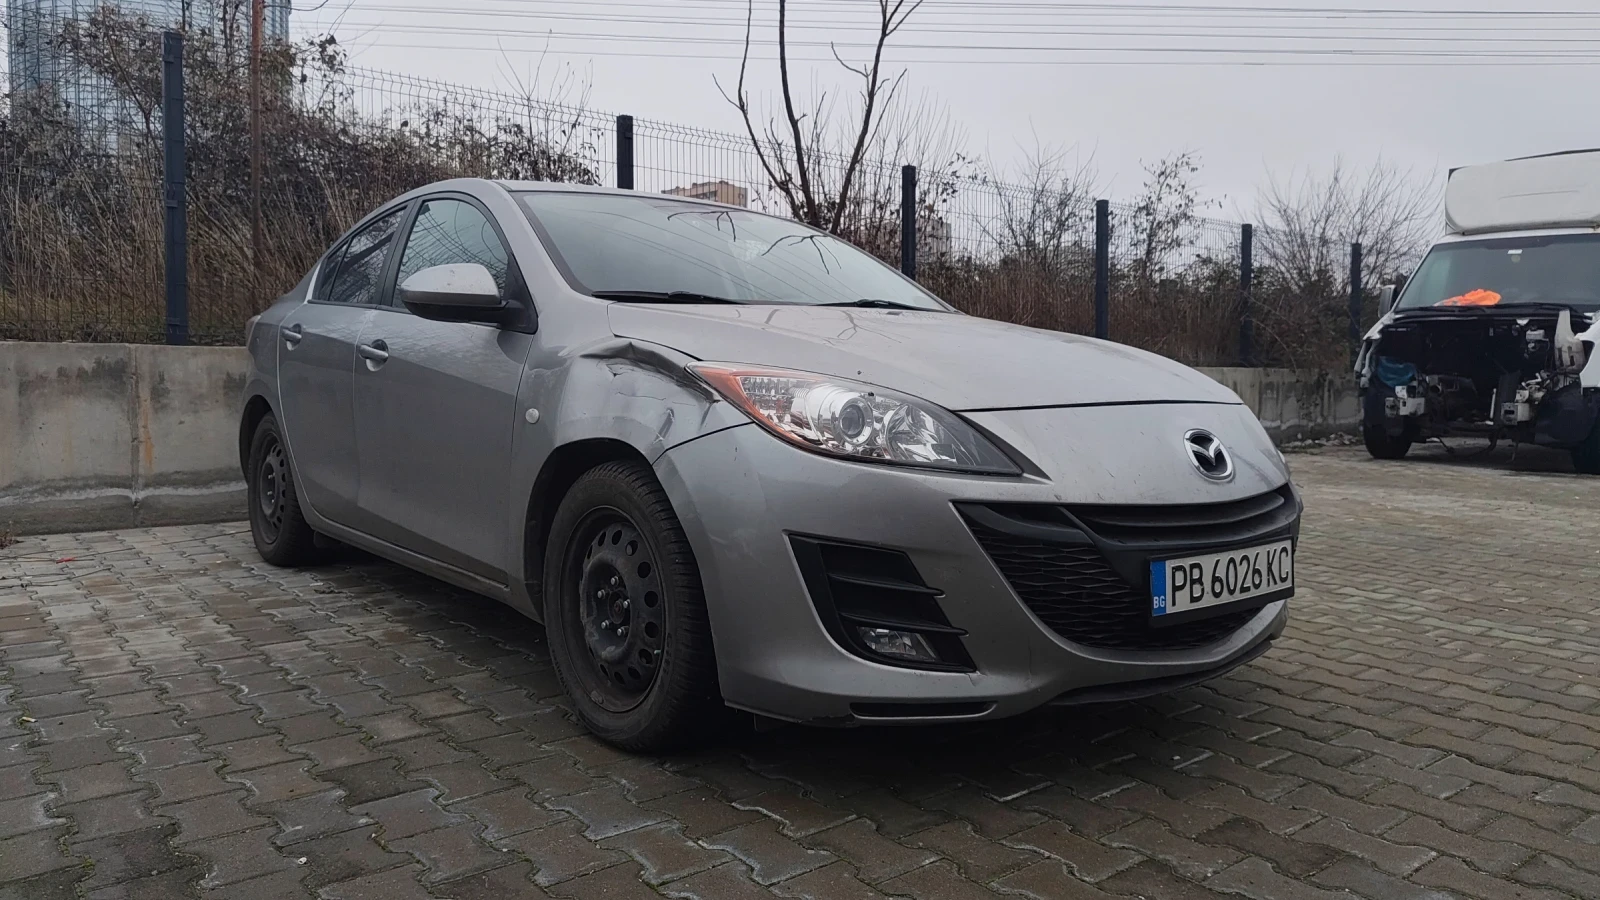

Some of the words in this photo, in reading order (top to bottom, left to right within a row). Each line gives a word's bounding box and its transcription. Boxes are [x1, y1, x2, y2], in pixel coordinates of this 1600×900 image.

[1171, 562, 1205, 607] PB
[1211, 552, 1263, 598] 6026
[1267, 546, 1289, 587] KC
[1153, 596, 1165, 609] BG
